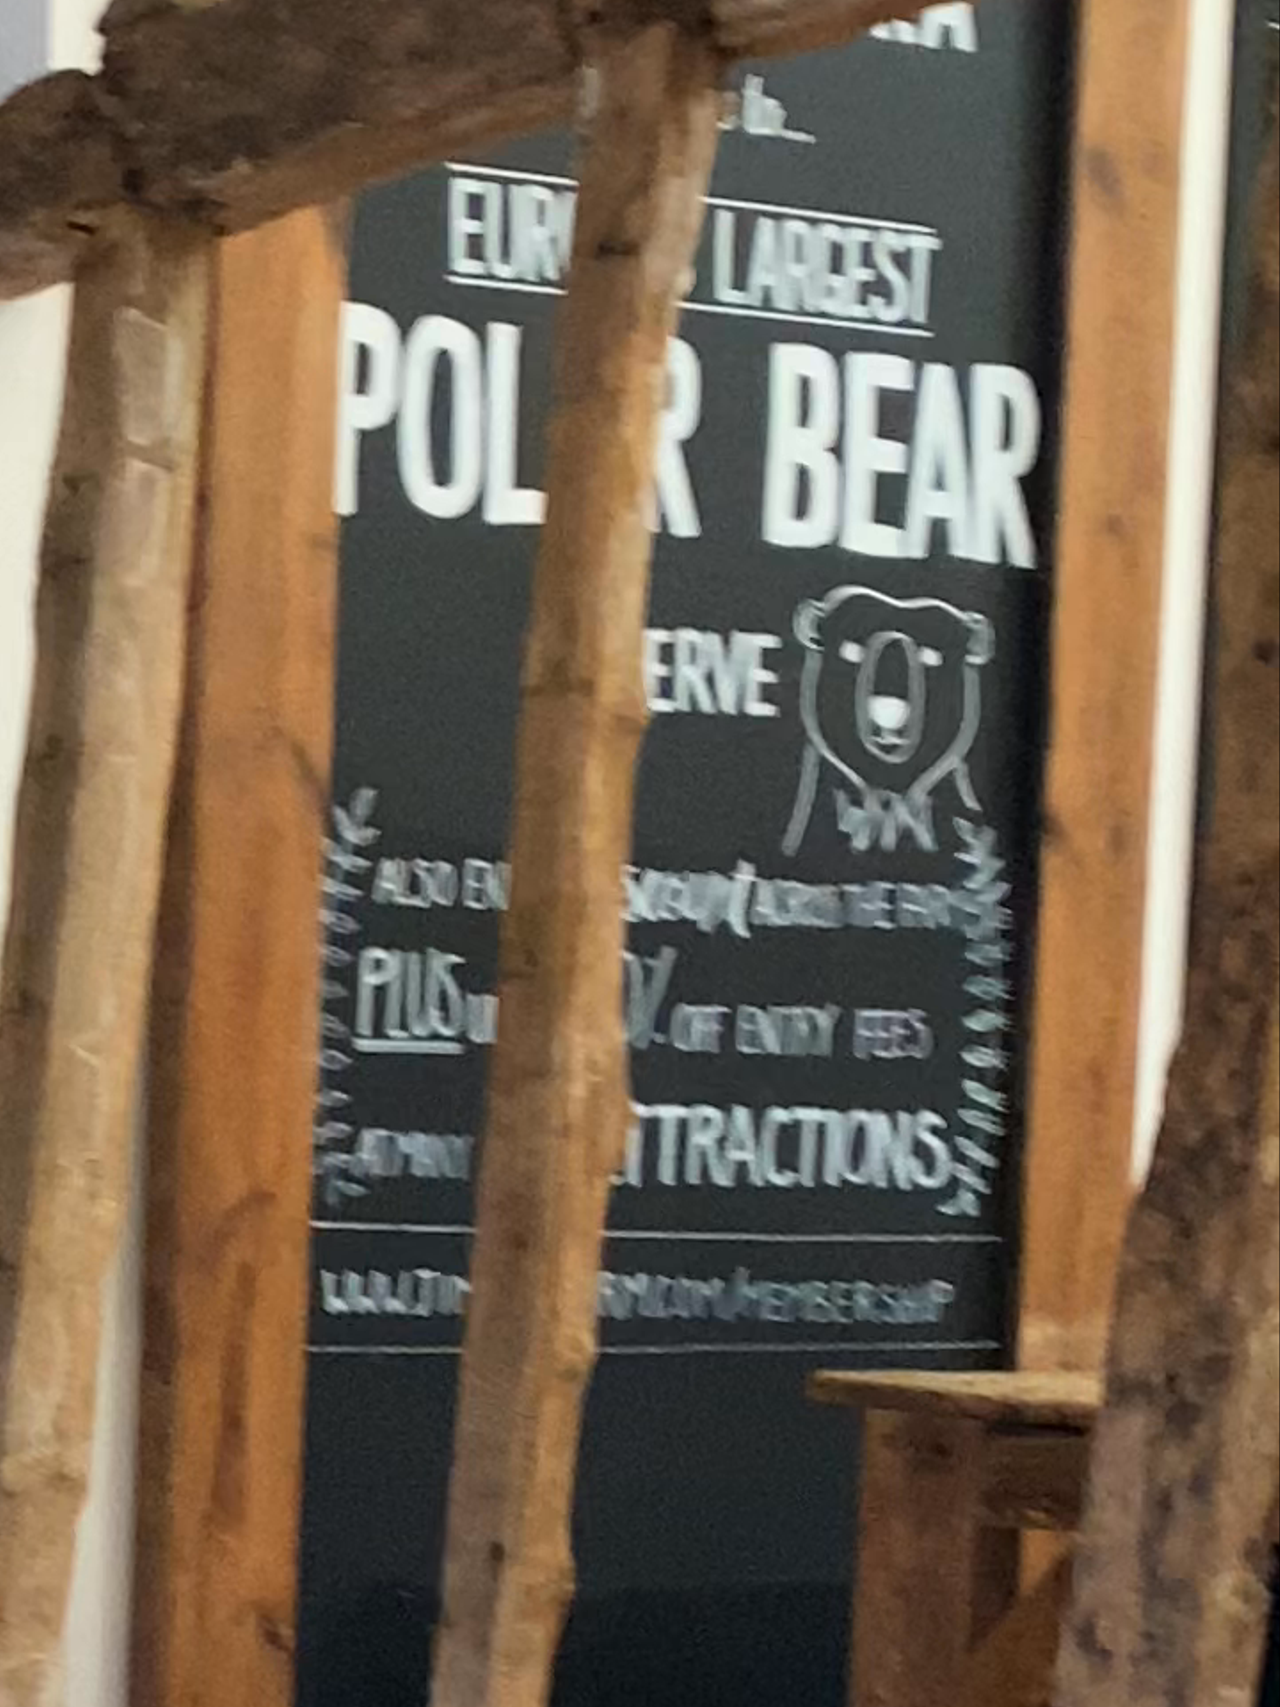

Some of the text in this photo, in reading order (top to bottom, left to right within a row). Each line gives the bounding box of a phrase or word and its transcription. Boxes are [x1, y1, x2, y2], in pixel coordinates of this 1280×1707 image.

[713, 208, 943, 324] LARGEST
[333, 300, 1042, 570] POLR BEAR
[641, 626, 782, 718] ERVE
[371, 857, 459, 909] ALSO
[354, 946, 467, 1038] PLUS
[610, 1101, 952, 1191] TTRACTIONS
